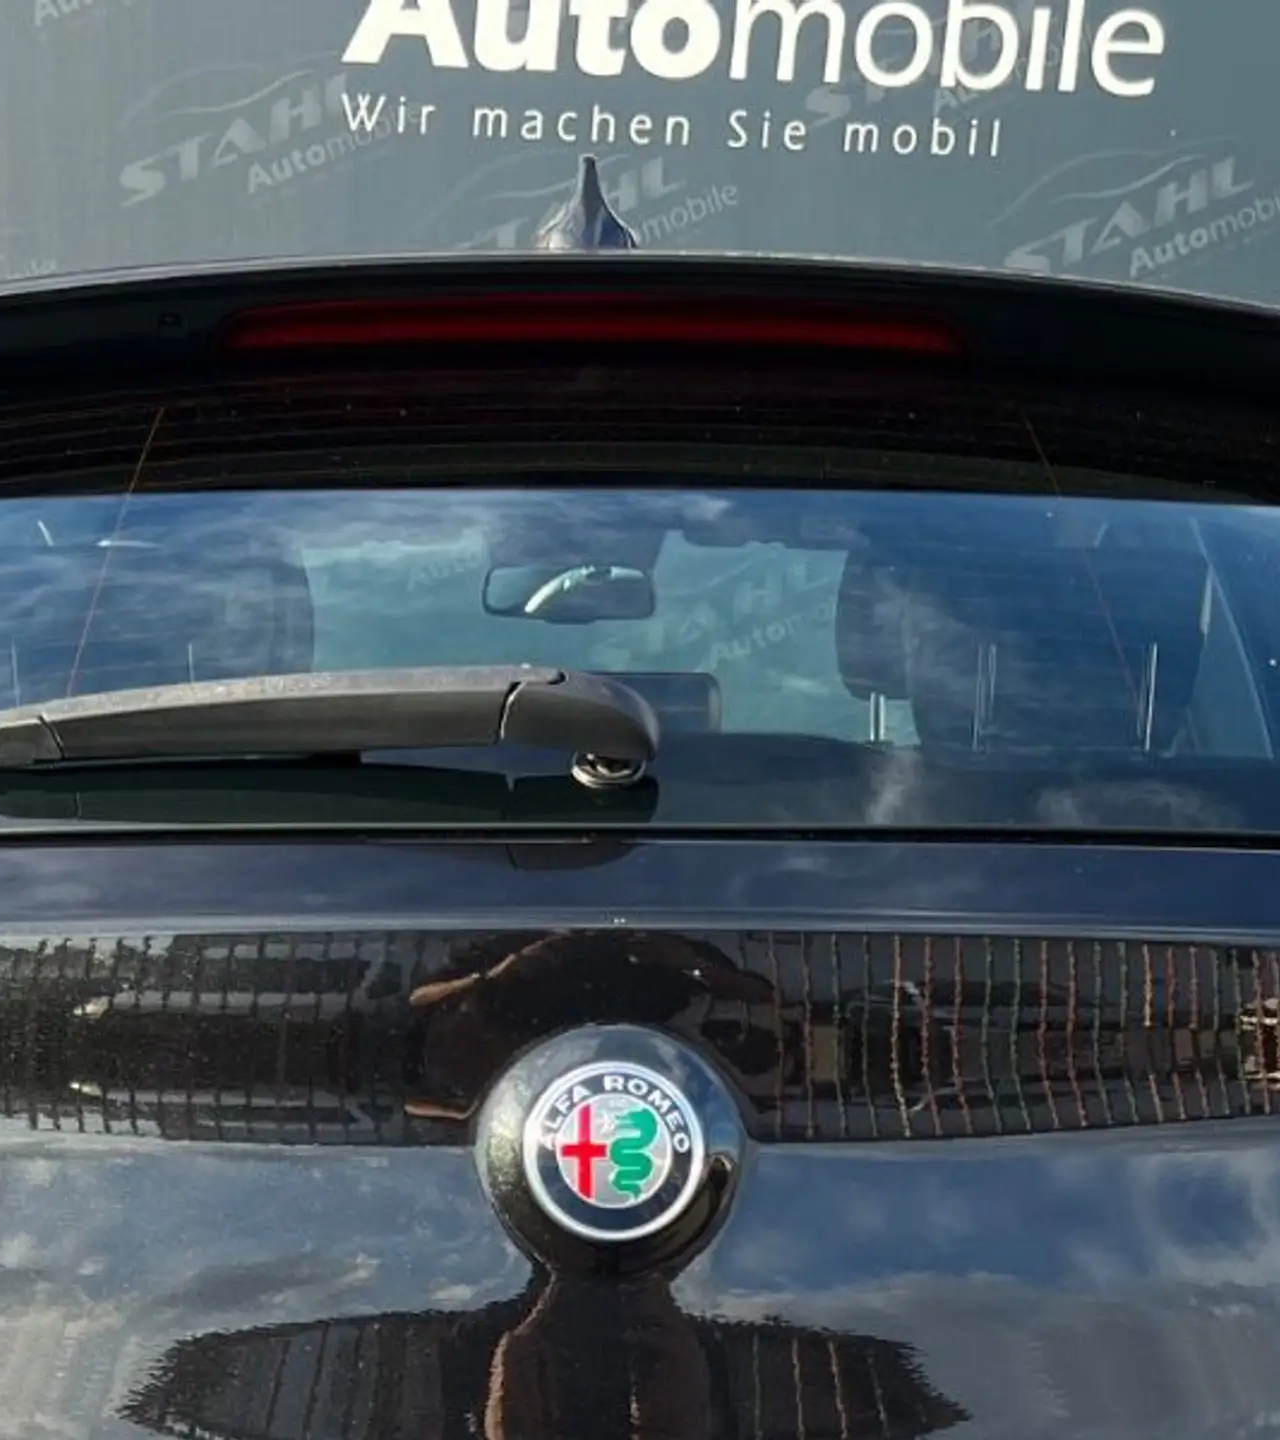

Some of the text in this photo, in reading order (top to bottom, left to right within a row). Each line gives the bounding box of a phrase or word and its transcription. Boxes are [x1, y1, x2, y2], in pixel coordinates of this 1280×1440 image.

[340, 92, 1003, 158] Wir machen Sie mobil
[540, 1074, 692, 1154] ALFA ROMEO
